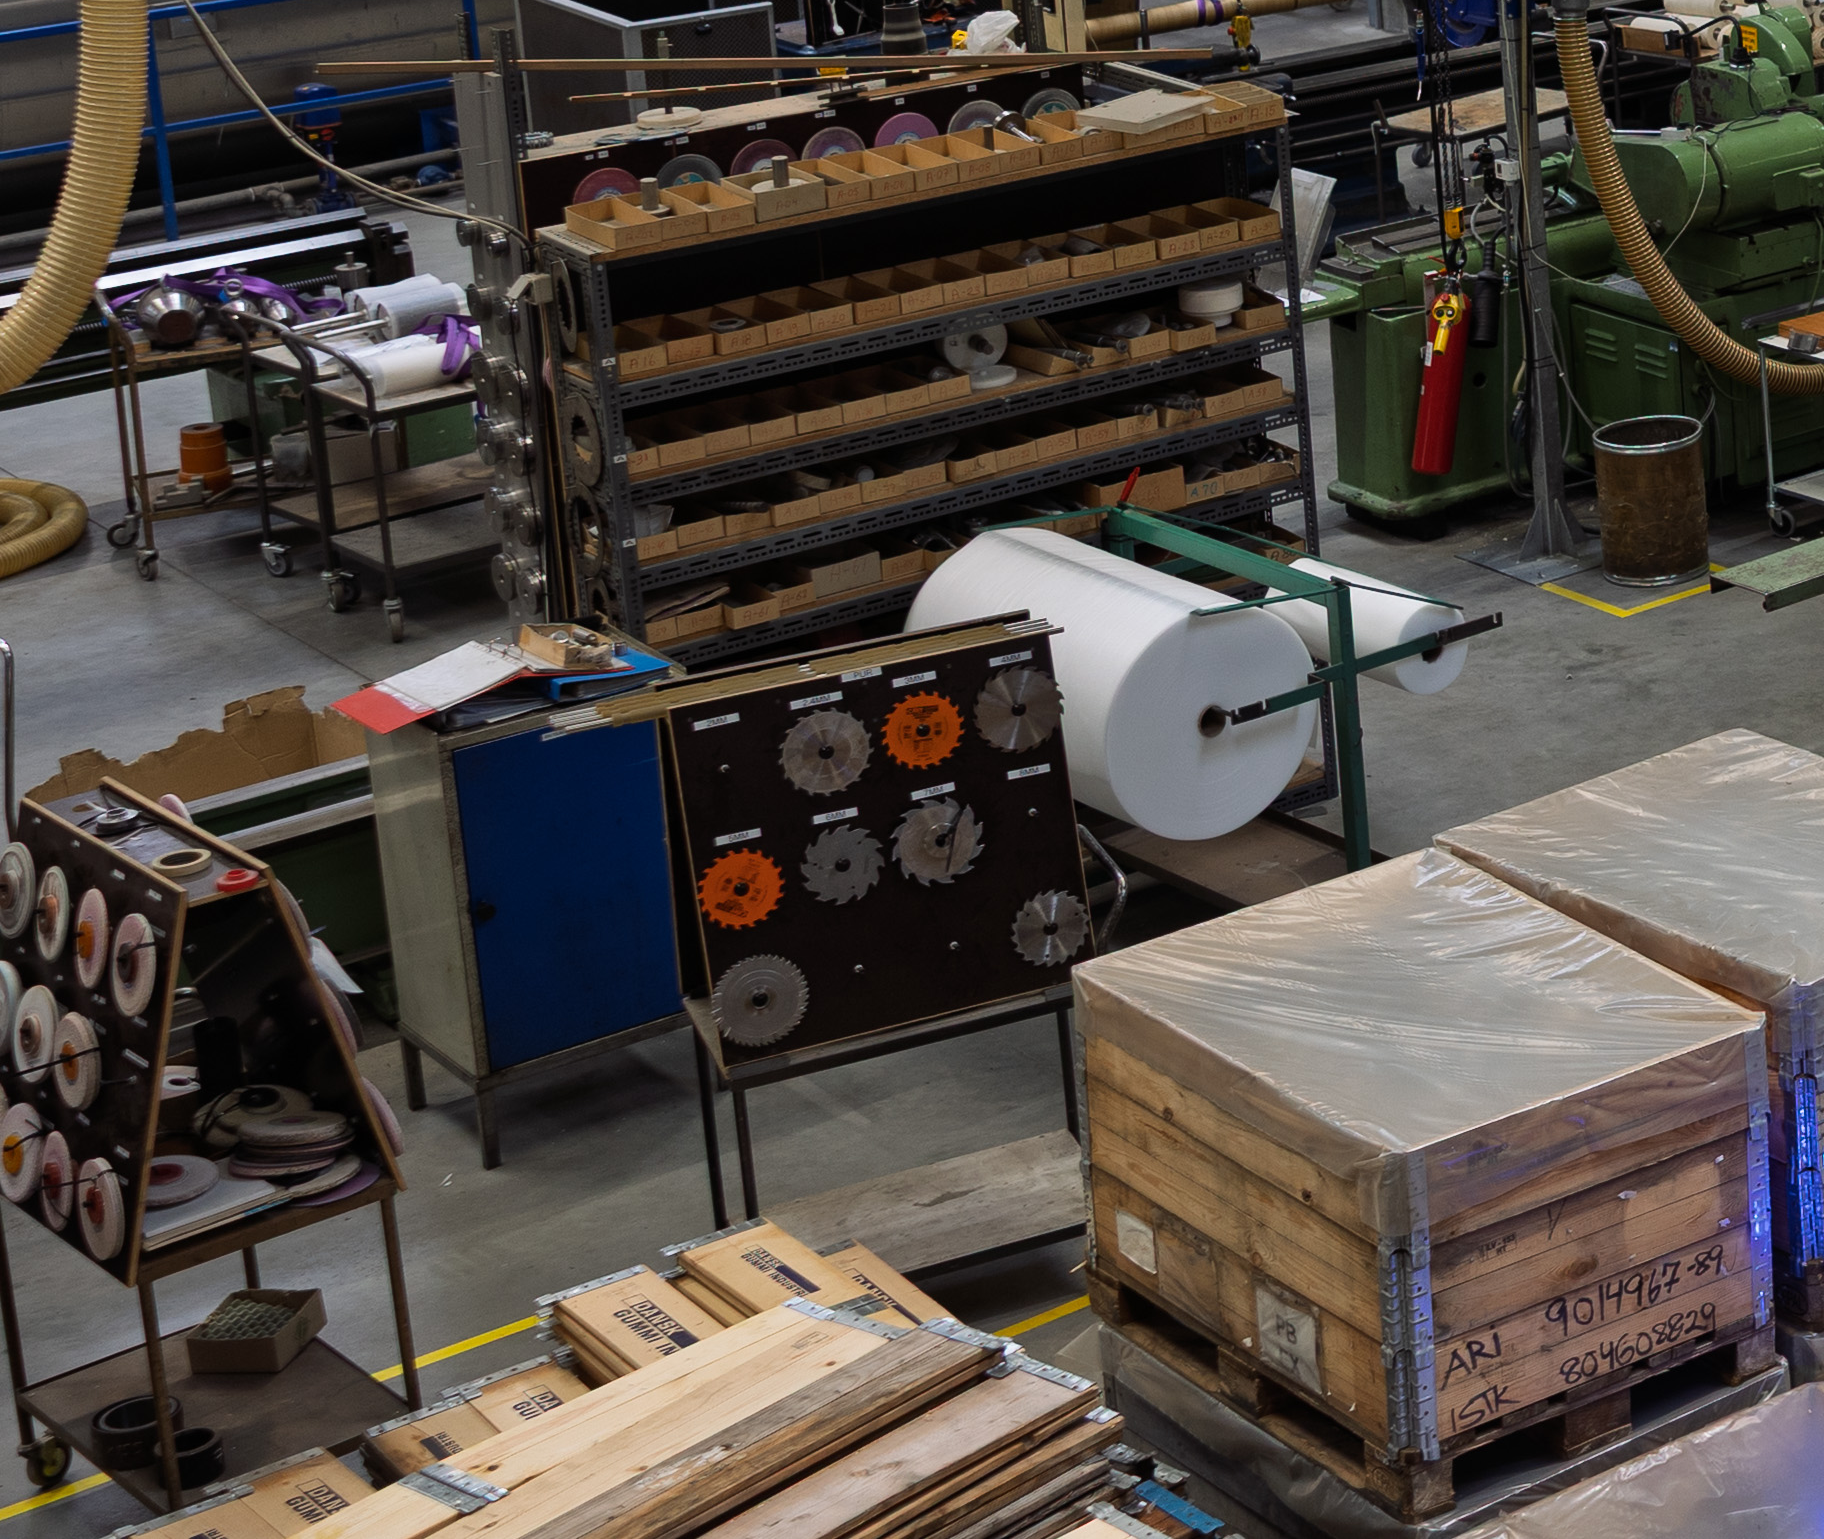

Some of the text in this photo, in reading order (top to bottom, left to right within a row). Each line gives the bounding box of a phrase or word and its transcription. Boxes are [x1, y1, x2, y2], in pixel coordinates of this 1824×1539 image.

[1250, 106, 1276, 121] A-15
[837, 188, 860, 200] A-05
[1202, 481, 1218, 494] 70
[853, 668, 873, 678] PUR
[904, 674, 925, 684] 3MM
[706, 716, 728, 727] 2MM
[633, 1299, 684, 1337] DANSK
[612, 1308, 682, 1357] GUMMI IN
[1275, 1314, 1298, 1345] PB
[532, 1390, 563, 1413] DA
[306, 1483, 352, 1516] DAN
